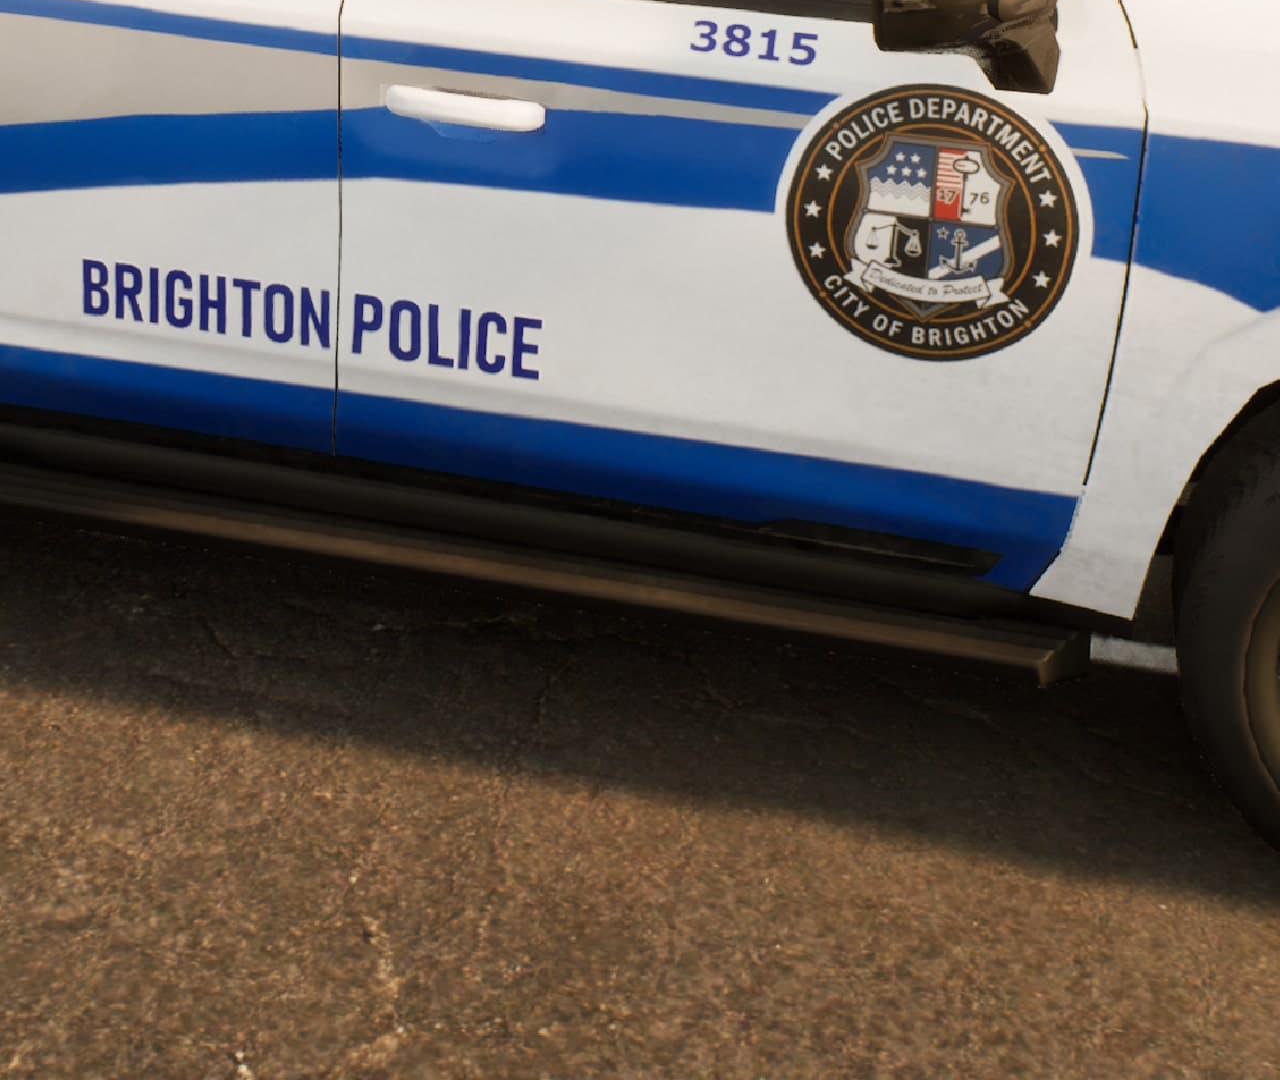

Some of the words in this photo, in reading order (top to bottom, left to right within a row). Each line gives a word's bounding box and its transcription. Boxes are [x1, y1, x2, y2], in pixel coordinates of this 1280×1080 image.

[690, 20, 818, 65] 3815
[825, 101, 903, 160] POLICE
[909, 97, 1053, 183] DEPARTMENT
[969, 191, 991, 206] 76
[82, 259, 331, 349] BRIGHTON
[351, 294, 542, 380] POLICE
[824, 275, 869, 318] CITY
[872, 313, 904, 337] OF
[911, 299, 1030, 346] BRIGHTON
